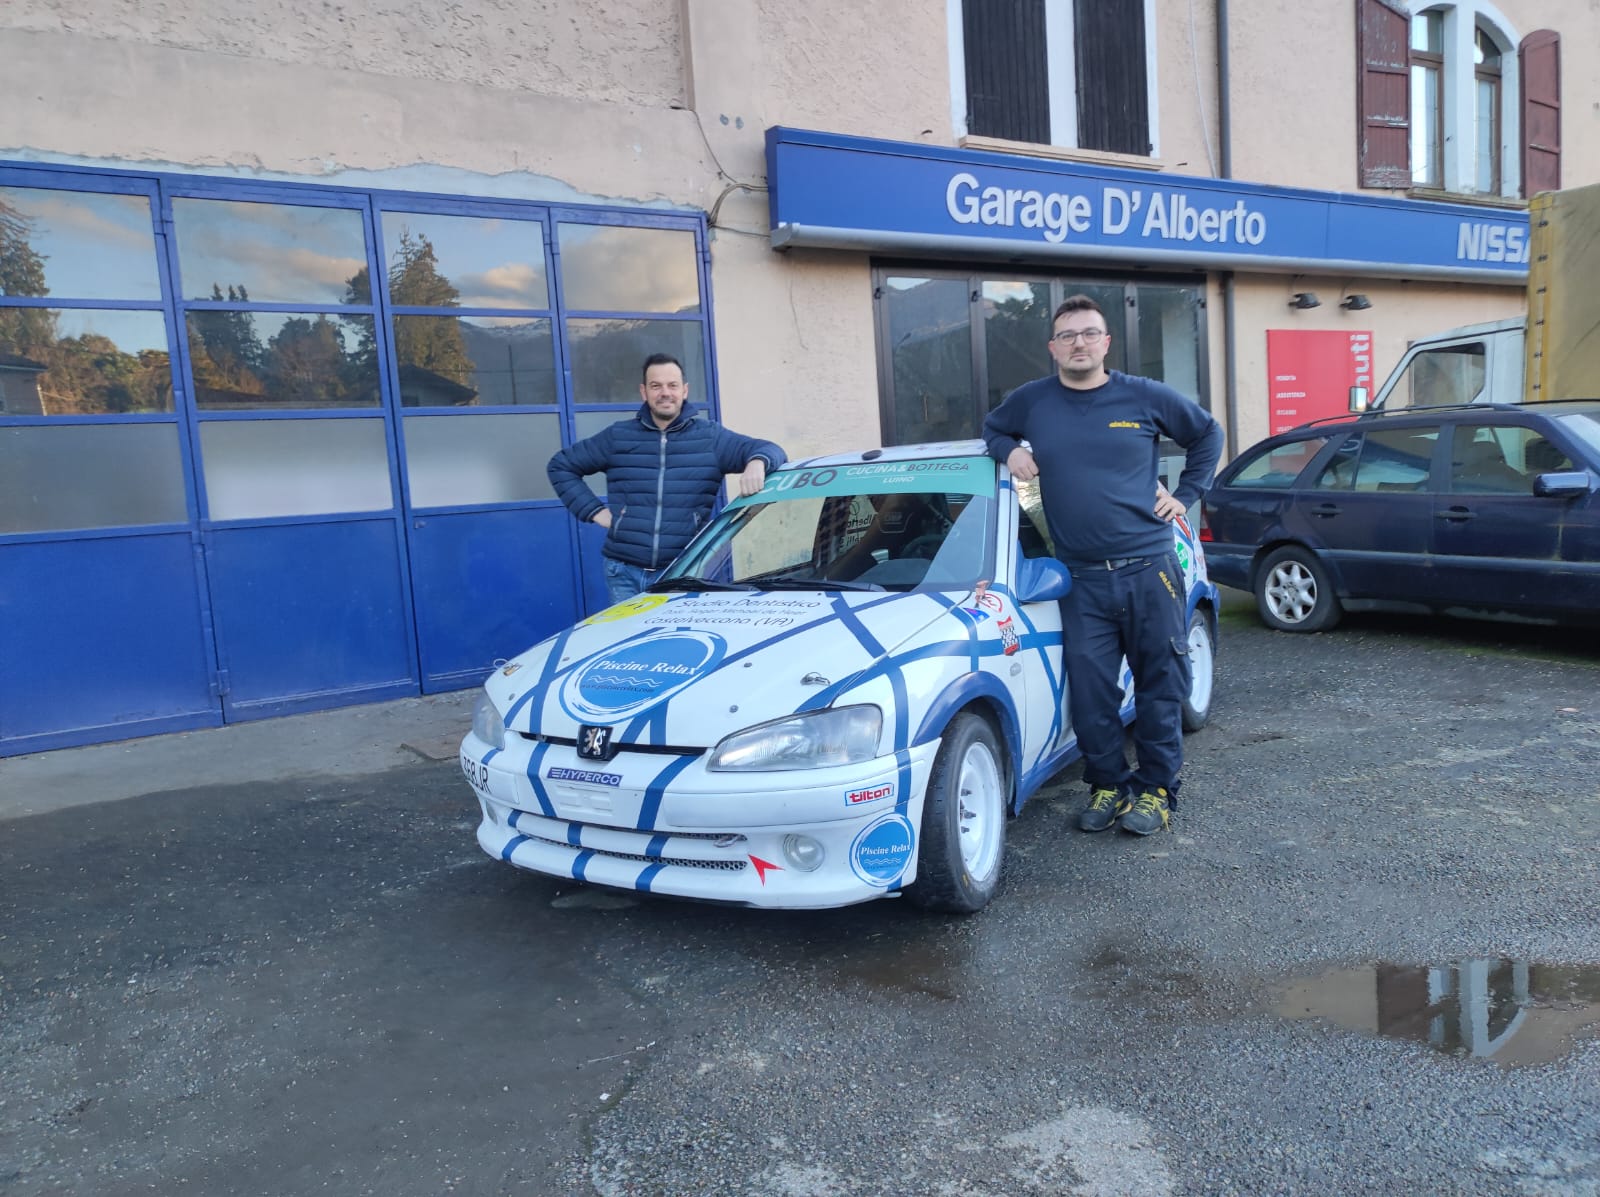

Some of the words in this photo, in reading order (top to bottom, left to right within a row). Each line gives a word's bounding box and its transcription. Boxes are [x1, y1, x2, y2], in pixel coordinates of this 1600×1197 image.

[946, 172, 1092, 243] Garage
[1102, 187, 1266, 245] D'Alberto
[762, 469, 837, 494] CUBO
[882, 476, 915, 484] LUINO
[676, 598, 731, 608] Studio
[733, 598, 821, 609] Dentistico
[754, 616, 796, 628] (VA)
[593, 660, 649, 672] Piscine
[649, 662, 697, 676] Relax
[559, 768, 621, 786] HYPERCO
[849, 786, 891, 803] tilton
[860, 846, 889, 855] Piscine
